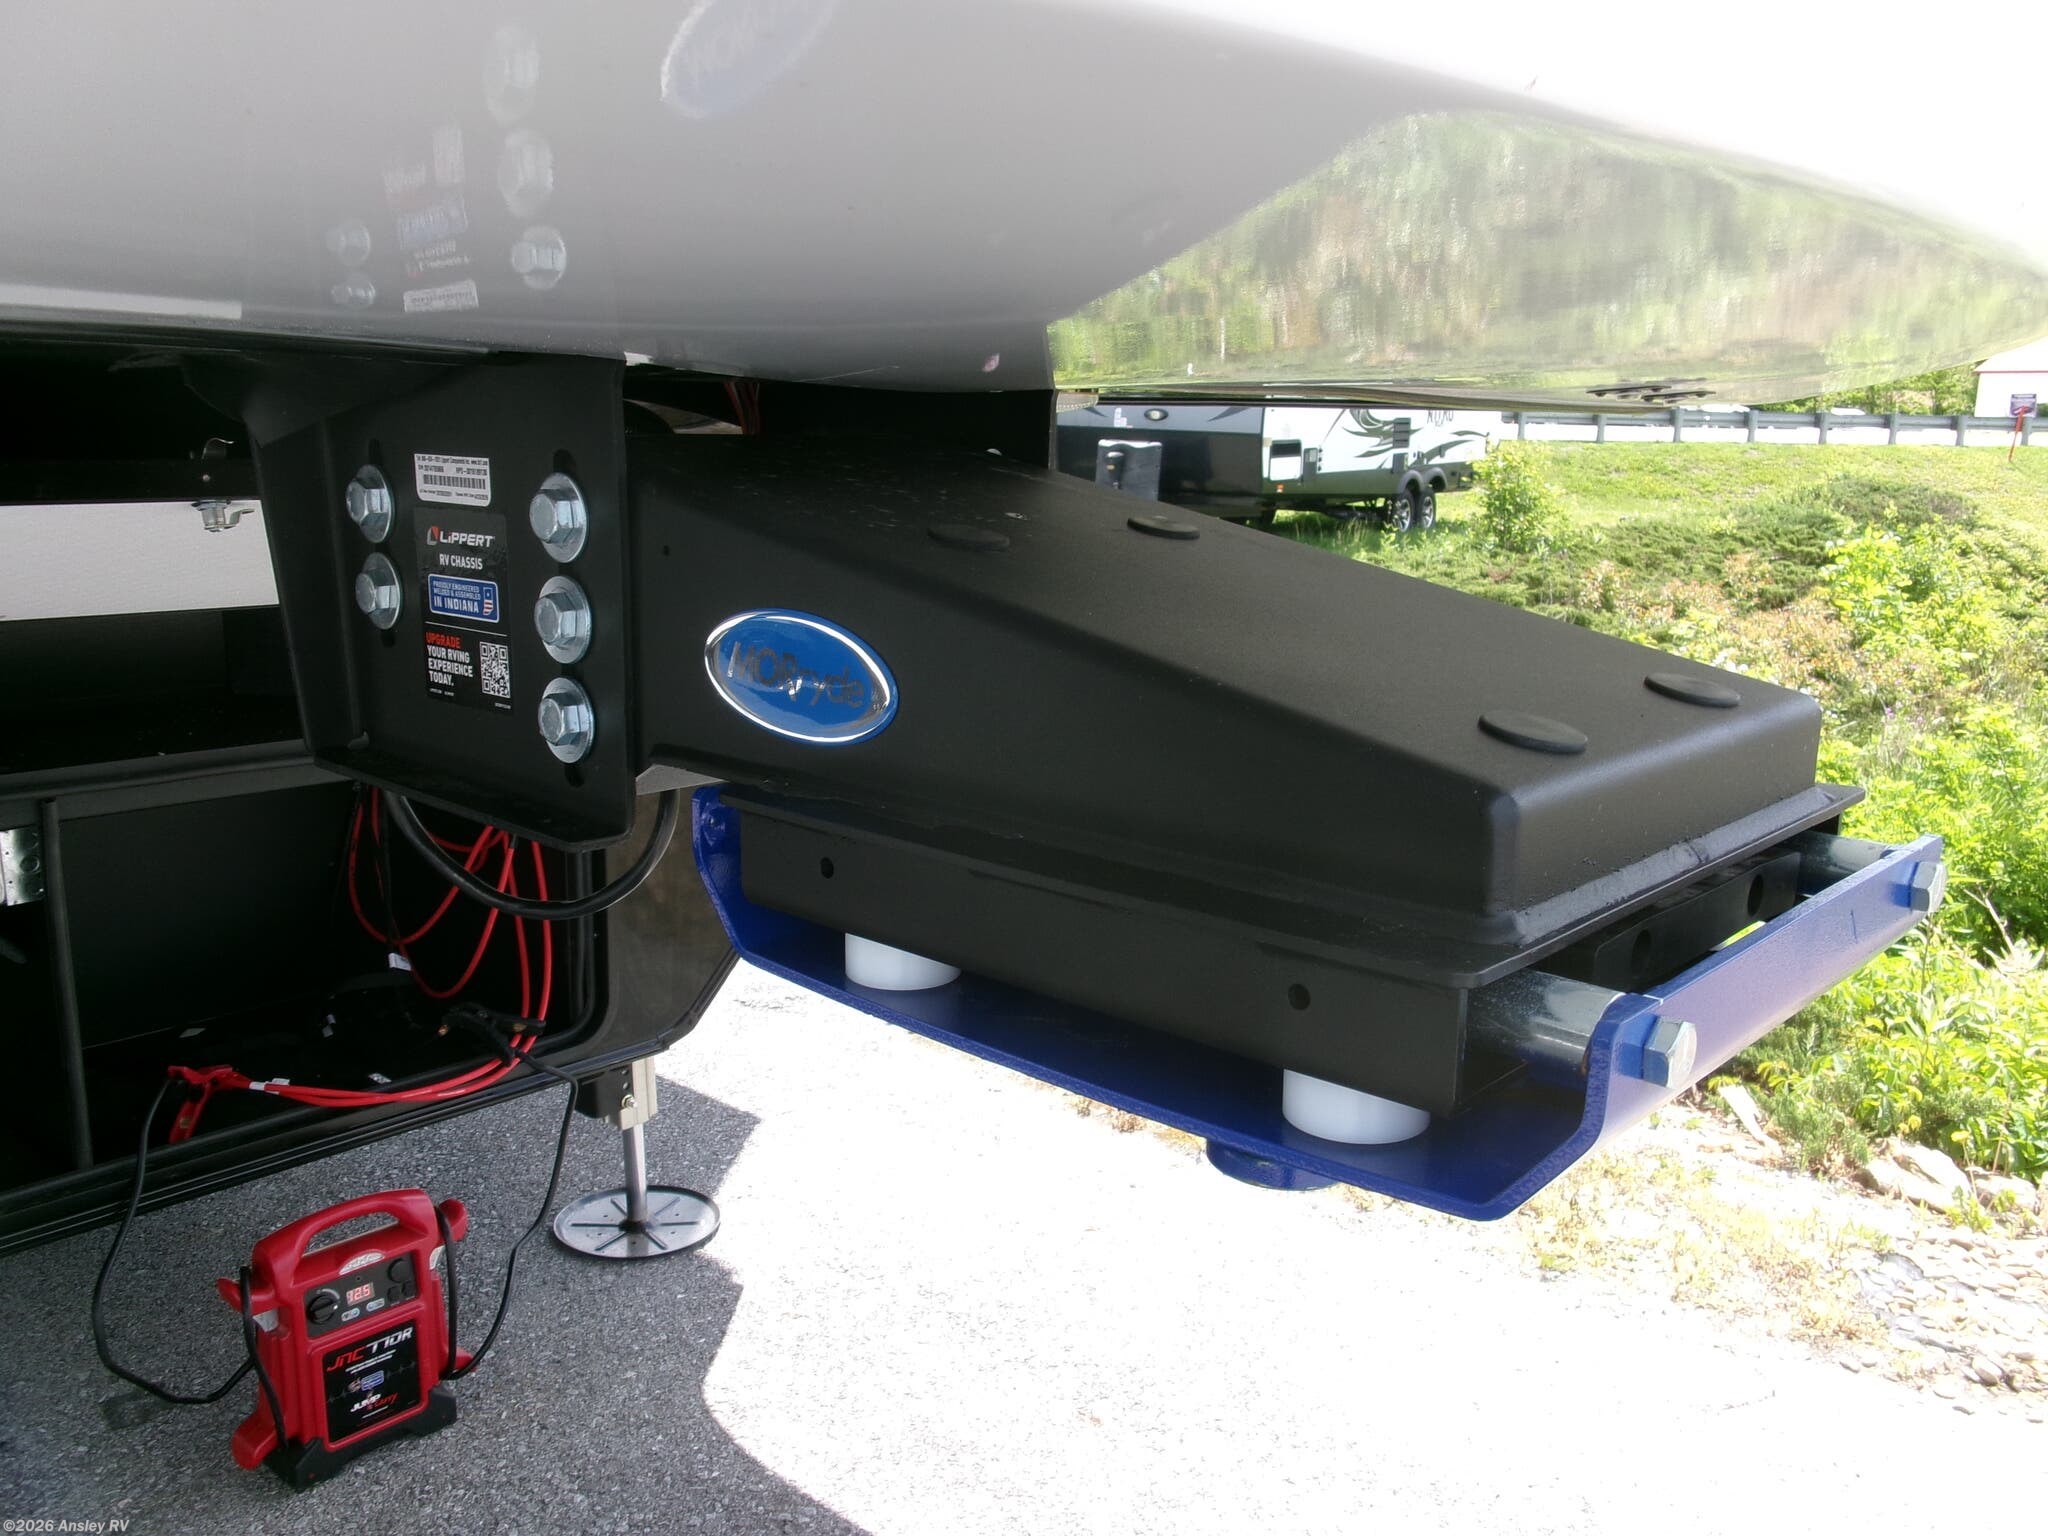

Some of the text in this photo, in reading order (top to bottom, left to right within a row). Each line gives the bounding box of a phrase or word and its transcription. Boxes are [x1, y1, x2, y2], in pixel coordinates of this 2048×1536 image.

[440, 553, 483, 570] RV CHASSIS
[452, 583, 480, 593] ENGINEERED
[434, 596, 479, 613] IN INDIANA
[426, 631, 461, 649] UPGRADE
[427, 645, 470, 663] YOUR RVING
[428, 658, 473, 677] EXPERIENCE
[428, 671, 454, 686] TODAY.
